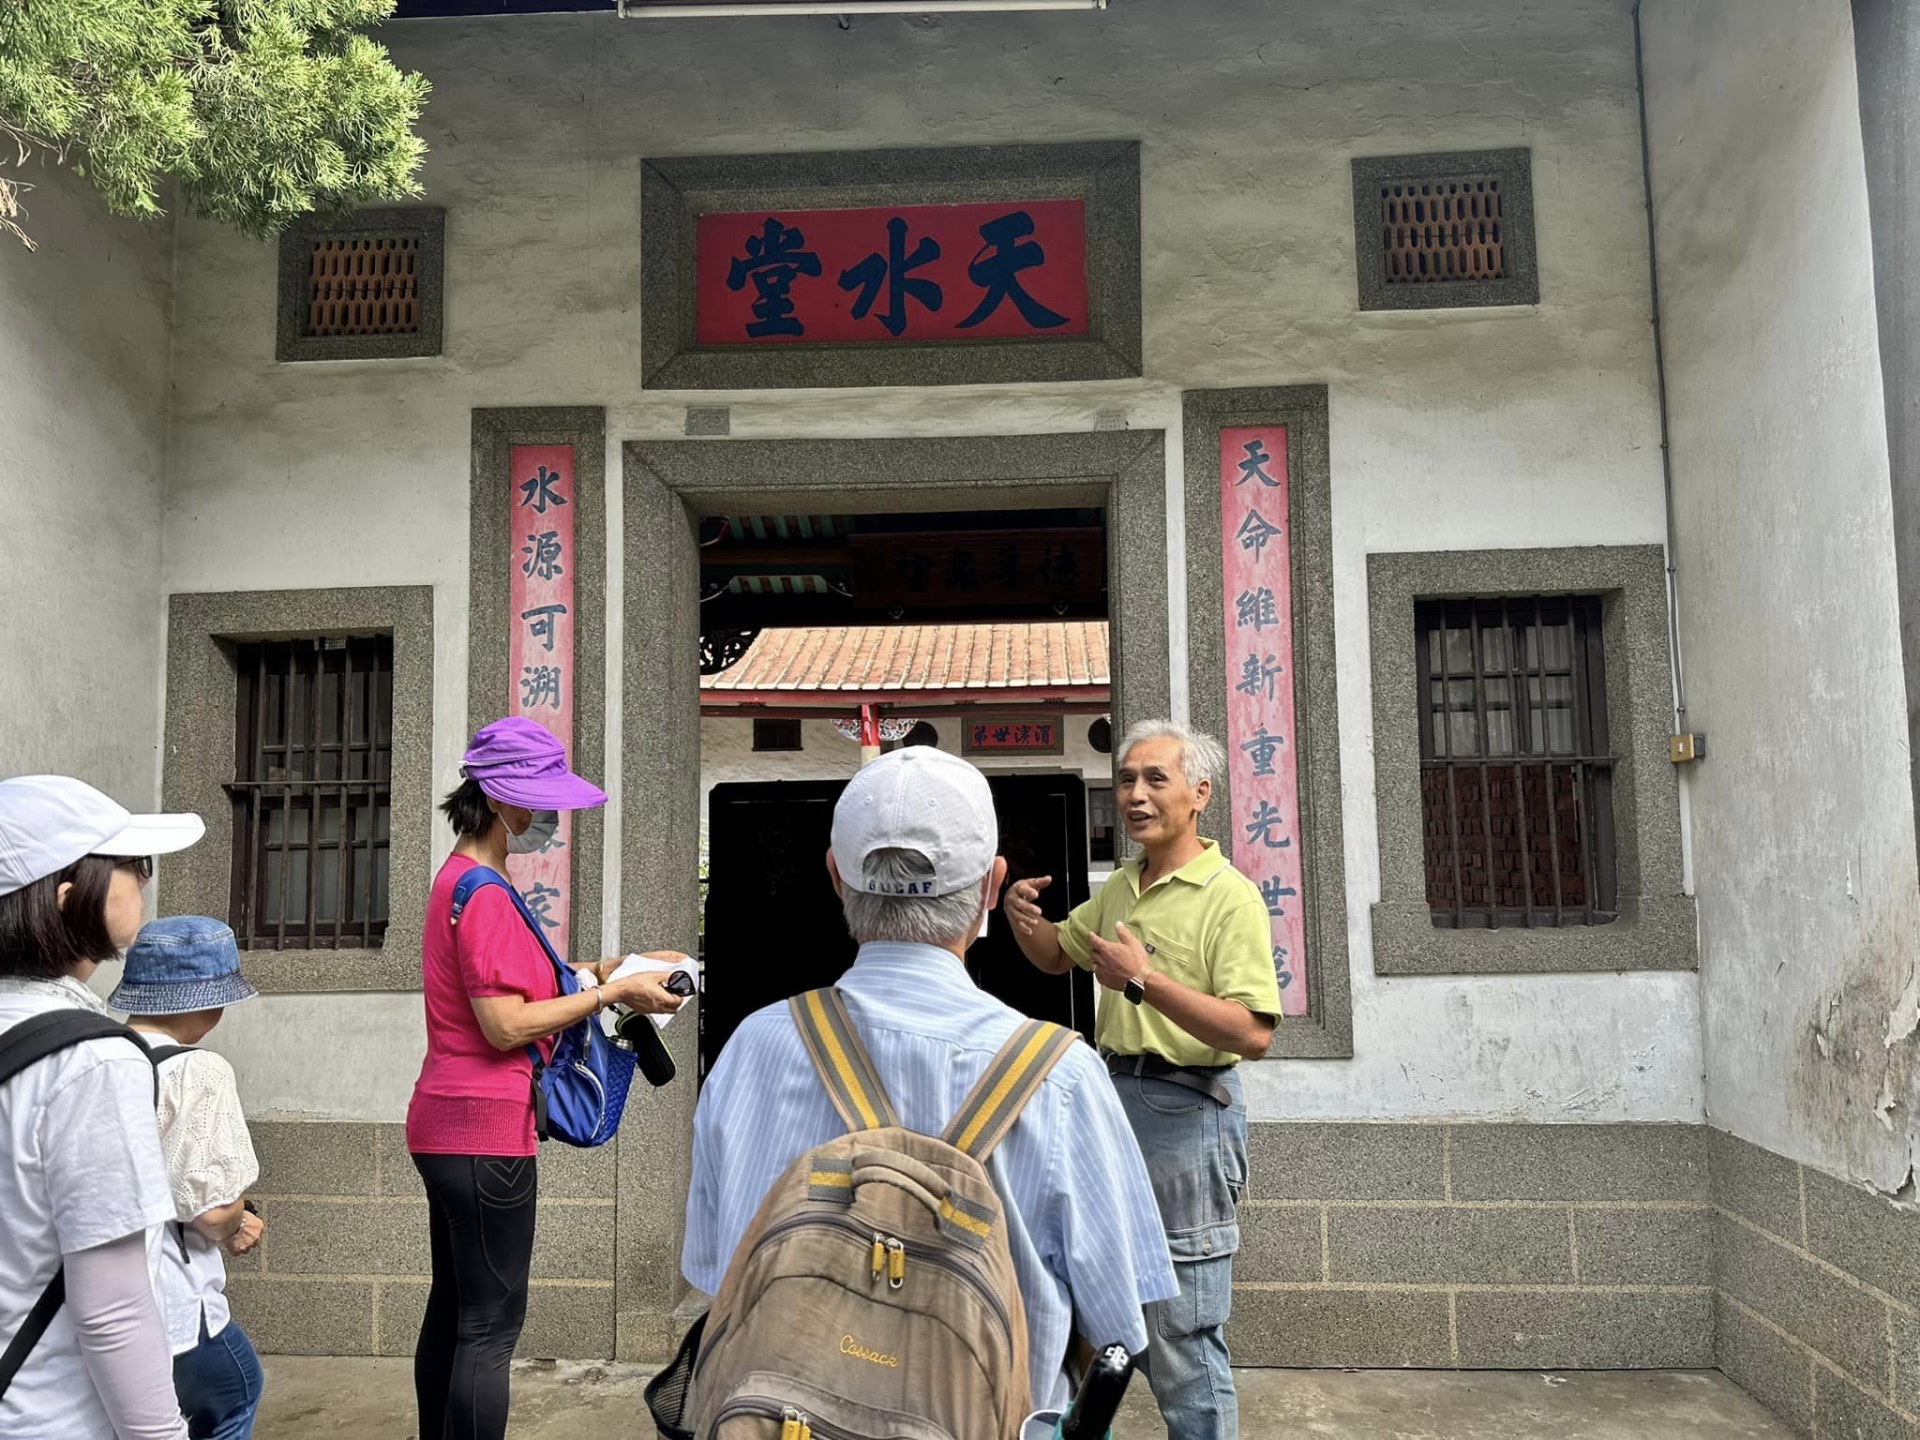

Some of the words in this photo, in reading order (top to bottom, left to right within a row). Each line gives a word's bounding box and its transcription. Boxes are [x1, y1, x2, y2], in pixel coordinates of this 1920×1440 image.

[726, 210, 1071, 338] 天水堂
[1234, 439, 1297, 990] 天命維新重光世
